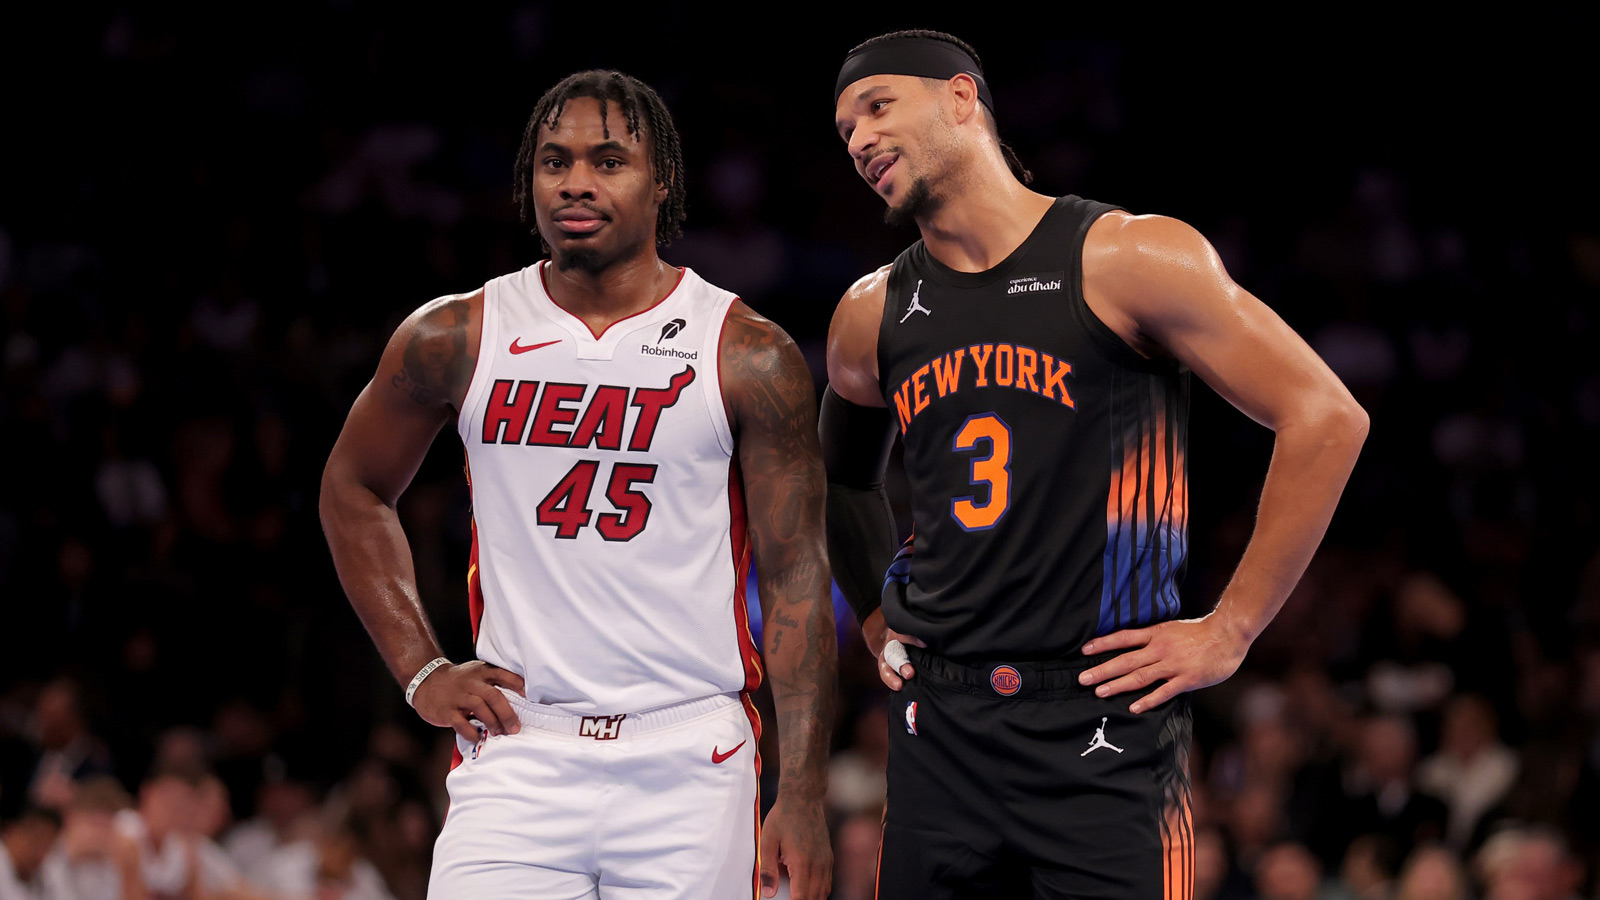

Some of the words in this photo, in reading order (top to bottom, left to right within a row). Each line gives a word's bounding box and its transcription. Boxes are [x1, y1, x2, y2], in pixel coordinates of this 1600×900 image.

[1007, 283, 1028, 295] abu
[1029, 279, 1062, 292] dhabi
[641, 344, 698, 360] Robinhood
[481, 363, 697, 453] HEAT
[892, 346, 966, 436] NEW
[969, 342, 1077, 412] YORK
[950, 411, 1013, 533] 3
[535, 459, 659, 543] 45
[416, 662, 436, 681] BEARS
[994, 674, 1017, 688] KNICKS
